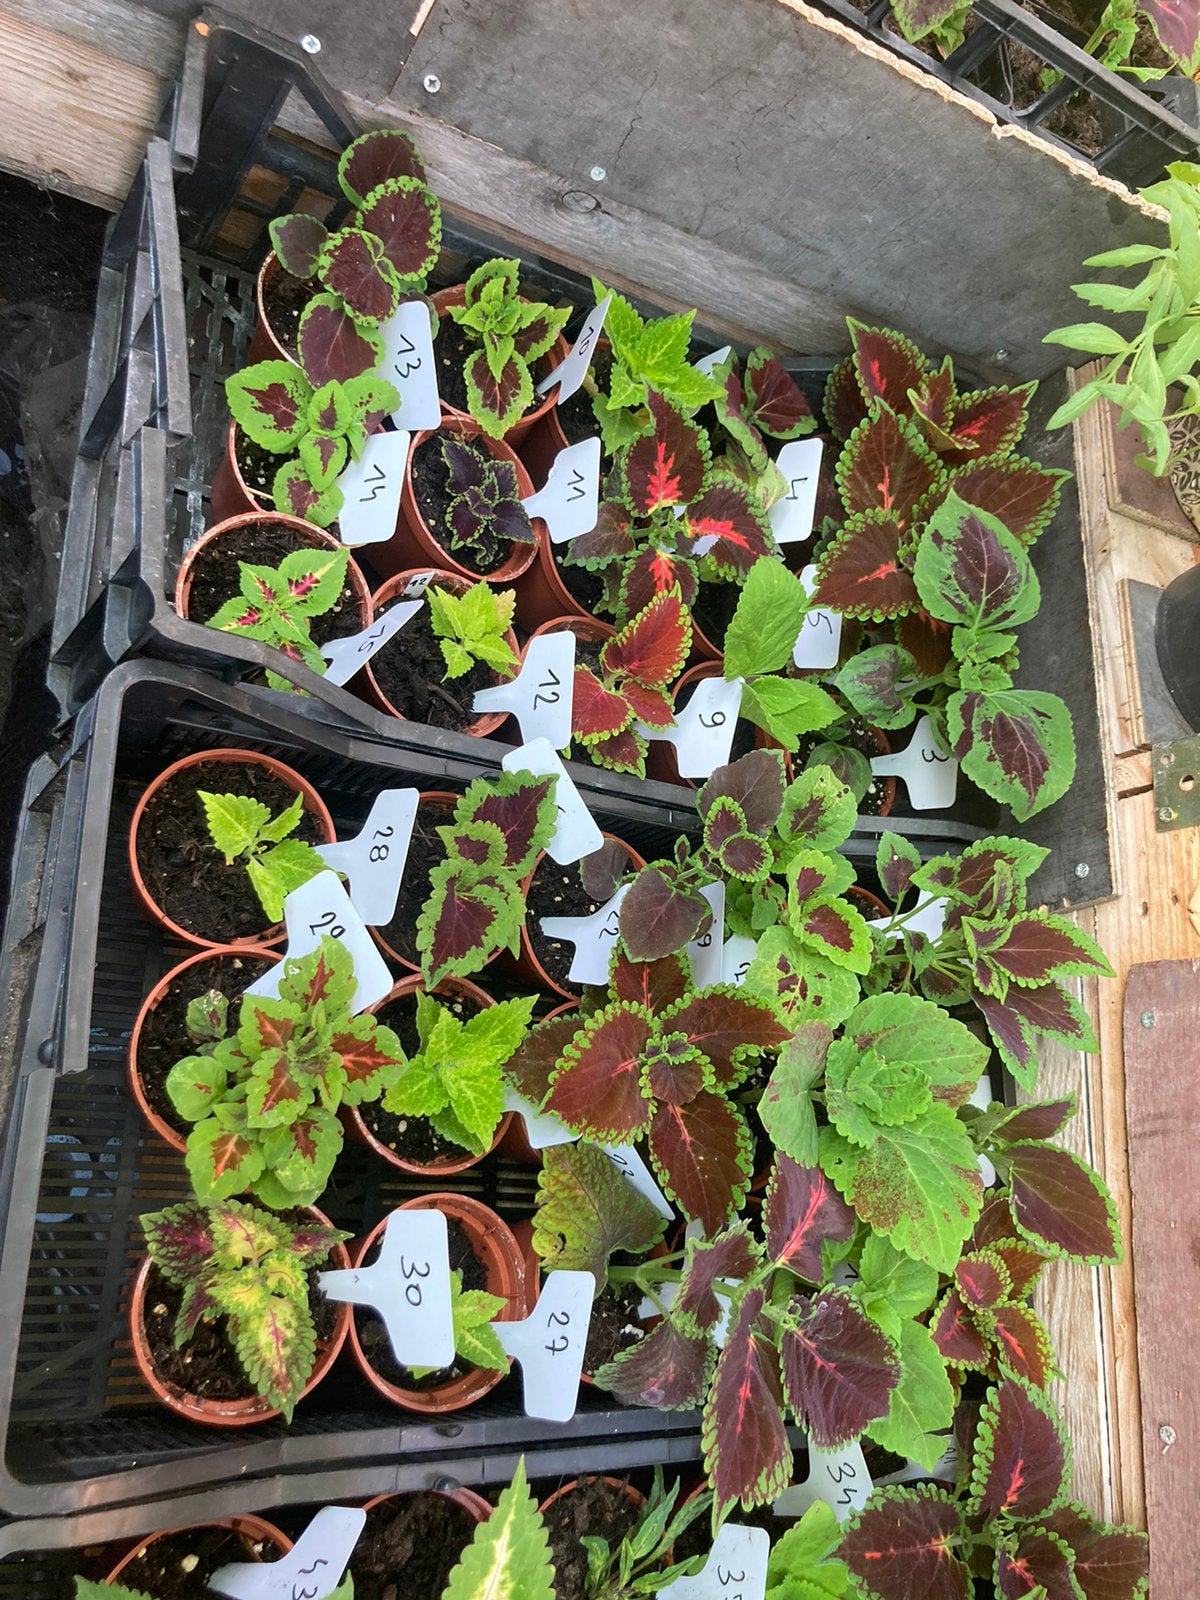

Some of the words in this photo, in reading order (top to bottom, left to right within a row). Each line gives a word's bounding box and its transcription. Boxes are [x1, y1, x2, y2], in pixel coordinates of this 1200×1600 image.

[394, 333, 422, 379] 13
[578, 326, 595, 356] 10
[359, 463, 388, 502] 14
[566, 469, 586, 502] 11
[785, 475, 808, 501] 4
[357, 624, 388, 654] 15
[533, 668, 562, 711] 12
[698, 710, 726, 728] 9
[922, 747, 949, 763] 3
[369, 825, 395, 863] 28
[399, 1255, 432, 1308] 30
[545, 1311, 571, 1356] 27
[826, 1460, 860, 1506] 34
